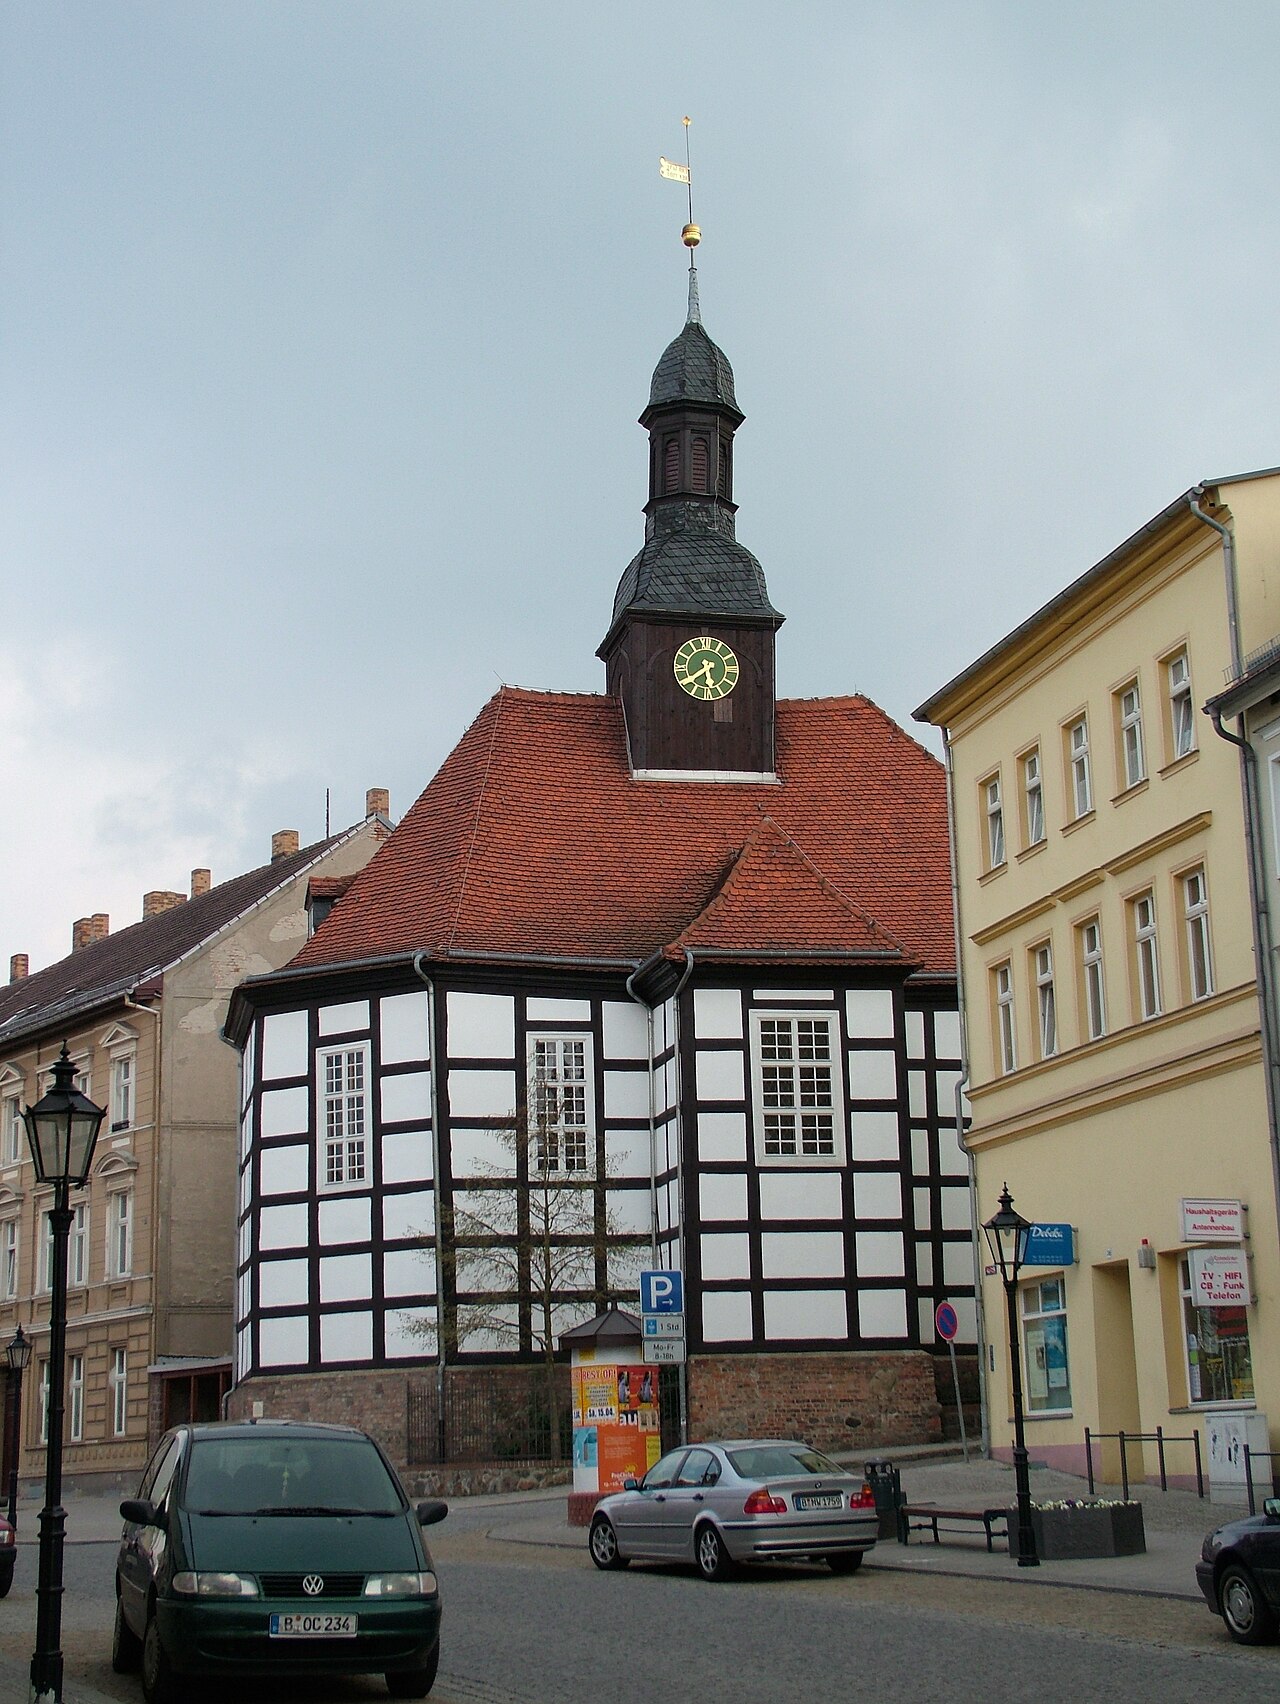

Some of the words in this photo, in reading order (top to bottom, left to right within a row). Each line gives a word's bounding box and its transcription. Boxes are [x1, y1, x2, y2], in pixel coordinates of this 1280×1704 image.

[1185, 1208, 1239, 1216] Haushaltsgeräte
[1201, 1272, 1214, 1280] TV
[1224, 1272, 1242, 1280] HIFI
[1200, 1282, 1213, 1290] CB
[1223, 1282, 1245, 1290] Funk
[650, 1275, 673, 1309] P
[667, 1323, 679, 1331] Std
[284, 1617, 293, 1631] B
[303, 1617, 321, 1631] OC
[324, 1617, 350, 1631] 234
